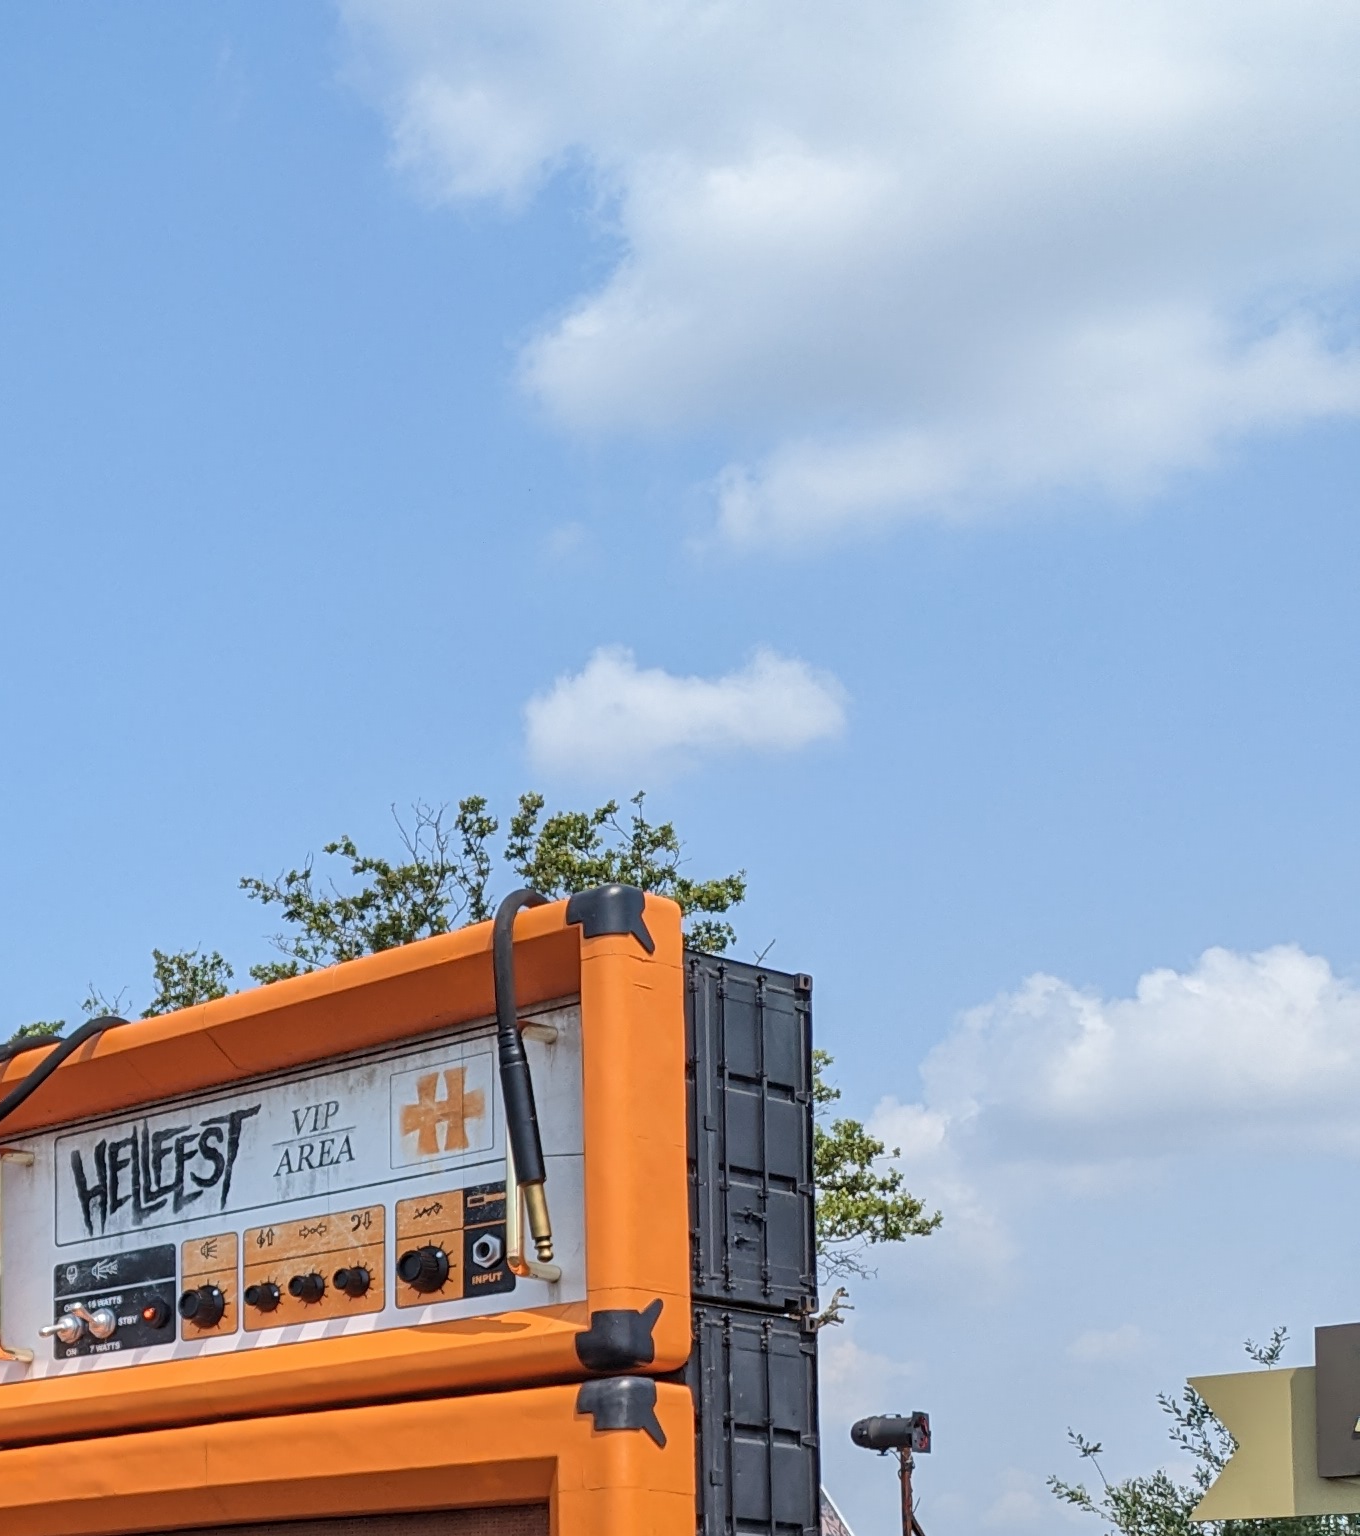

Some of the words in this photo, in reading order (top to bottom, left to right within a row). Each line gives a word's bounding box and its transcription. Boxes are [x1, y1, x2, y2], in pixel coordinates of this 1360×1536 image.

[291, 1100, 339, 1135] VIP
[273, 1134, 355, 1177] AREA
[70, 1103, 262, 1236] HELLFEST
[471, 1271, 503, 1286] INPUT
[97, 1295, 123, 1307] WATTS
[96, 1341, 121, 1352] WATTS
